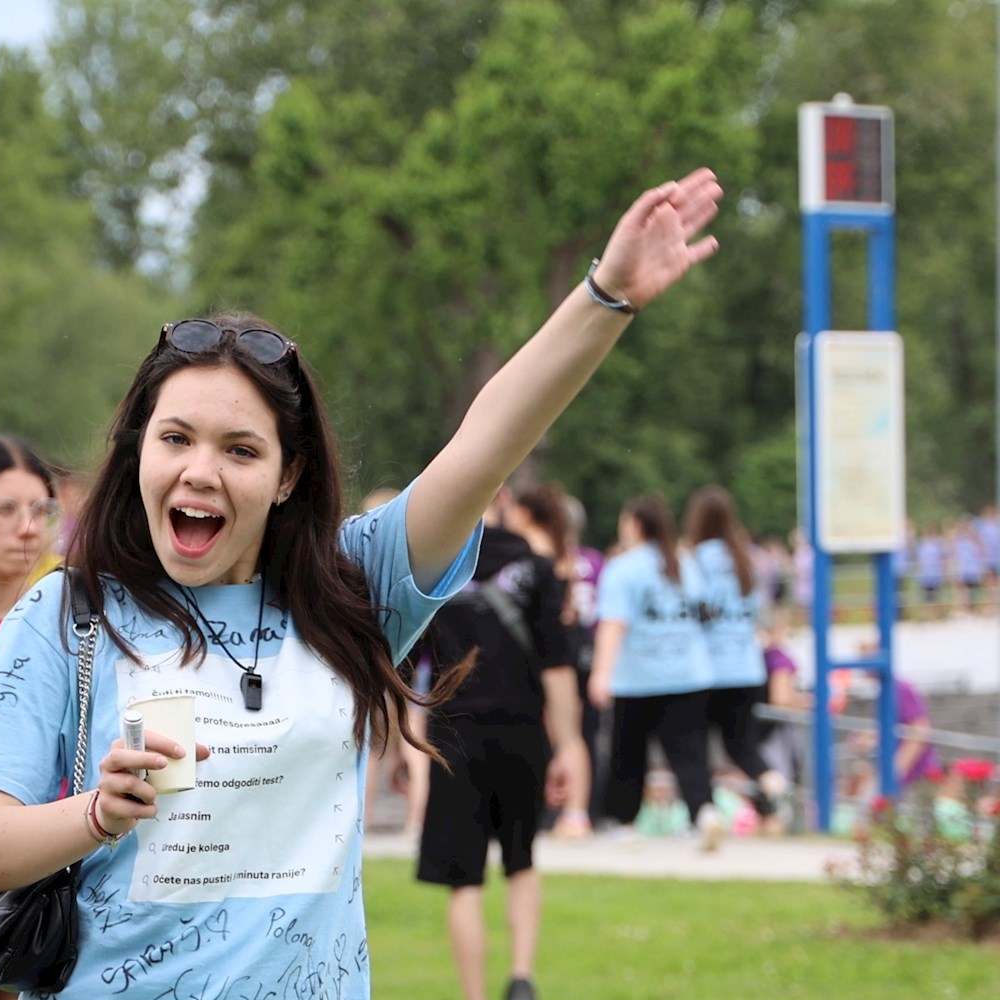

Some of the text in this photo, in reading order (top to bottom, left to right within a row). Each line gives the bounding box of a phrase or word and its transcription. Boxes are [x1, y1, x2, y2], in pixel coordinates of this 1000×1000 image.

[233, 744, 278, 754] timsima?
[222, 776, 261, 789] odgoditi
[262, 775, 284, 786] test?
[186, 843, 196, 854] je
[199, 843, 230, 853] kolega
[153, 874, 181, 885] Oćete
[203, 873, 233, 885] pustiti
[271, 868, 306, 879] ranije?
